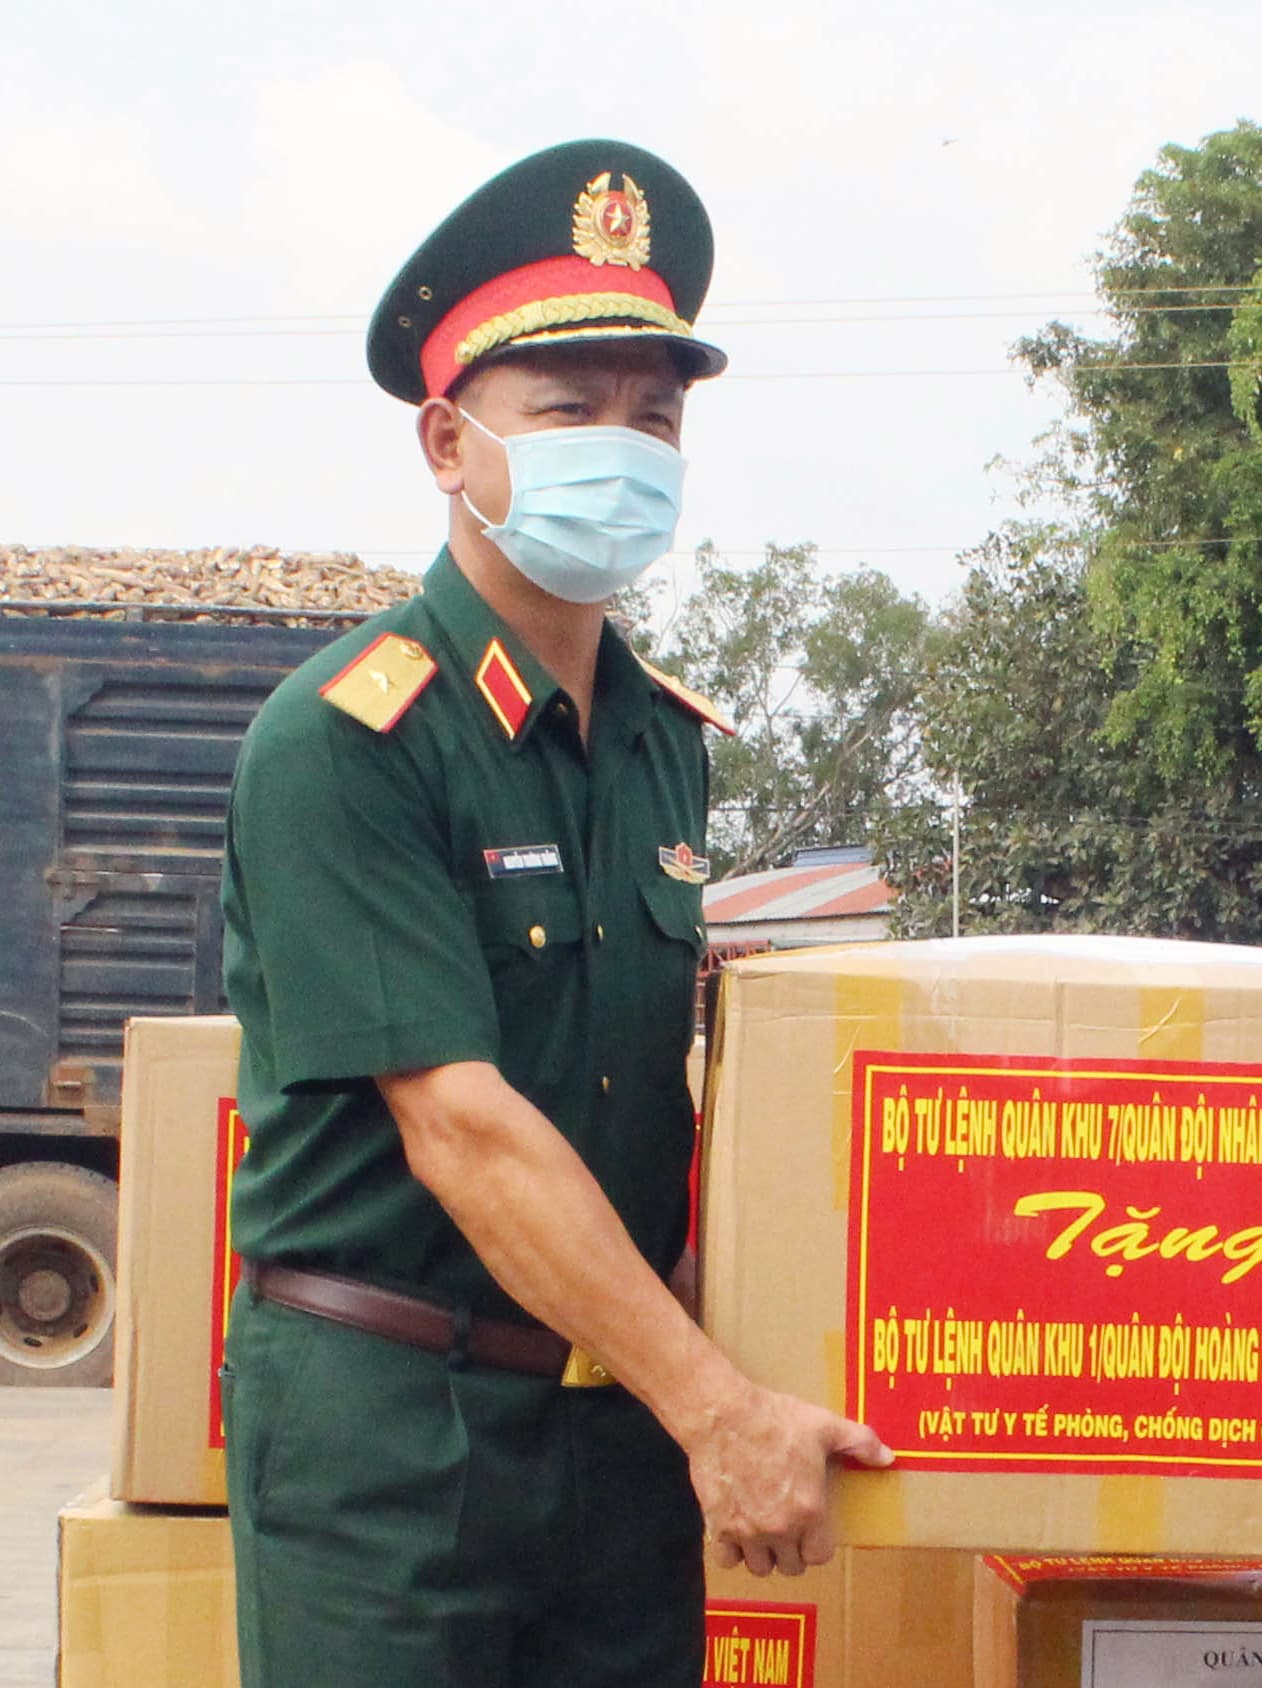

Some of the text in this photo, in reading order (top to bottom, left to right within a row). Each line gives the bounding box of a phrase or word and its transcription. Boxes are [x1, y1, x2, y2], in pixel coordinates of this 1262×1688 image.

[882, 1084, 910, 1171] BỘ
[914, 1086, 943, 1156] TƯ
[944, 1085, 997, 1173] LỆNH
[1001, 1087, 1056, 1160] QUÂN
[1061, 1102, 1103, 1160] KHU
[1108, 1091, 1176, 1166] 7/QUÂN
[1180, 1093, 1214, 1180] ĐỘI
[873, 1305, 899, 1389] BỘ
[904, 1308, 931, 1373] TƯ
[933, 1306, 983, 1391] LỆNH
[987, 1308, 1040, 1379] QUÂN
[1044, 1322, 1084, 1378] KHU
[1158, 1312, 1190, 1395] ĐỘI
[1194, 1312, 1259, 1383] HOÀNG
[918, 1406, 966, 1442] (VẬT
[971, 1408, 1000, 1435] TƯ
[1003, 1413, 1017, 1436] Y
[1022, 1403, 1049, 1437] TẾ
[1053, 1408, 1129, 1443] PHÒNG,
[1134, 1406, 1203, 1440] CHỐNG
[1208, 1417, 1257, 1448] DỊCH
[714, 1625, 789, 1688] VIỆT NAM
